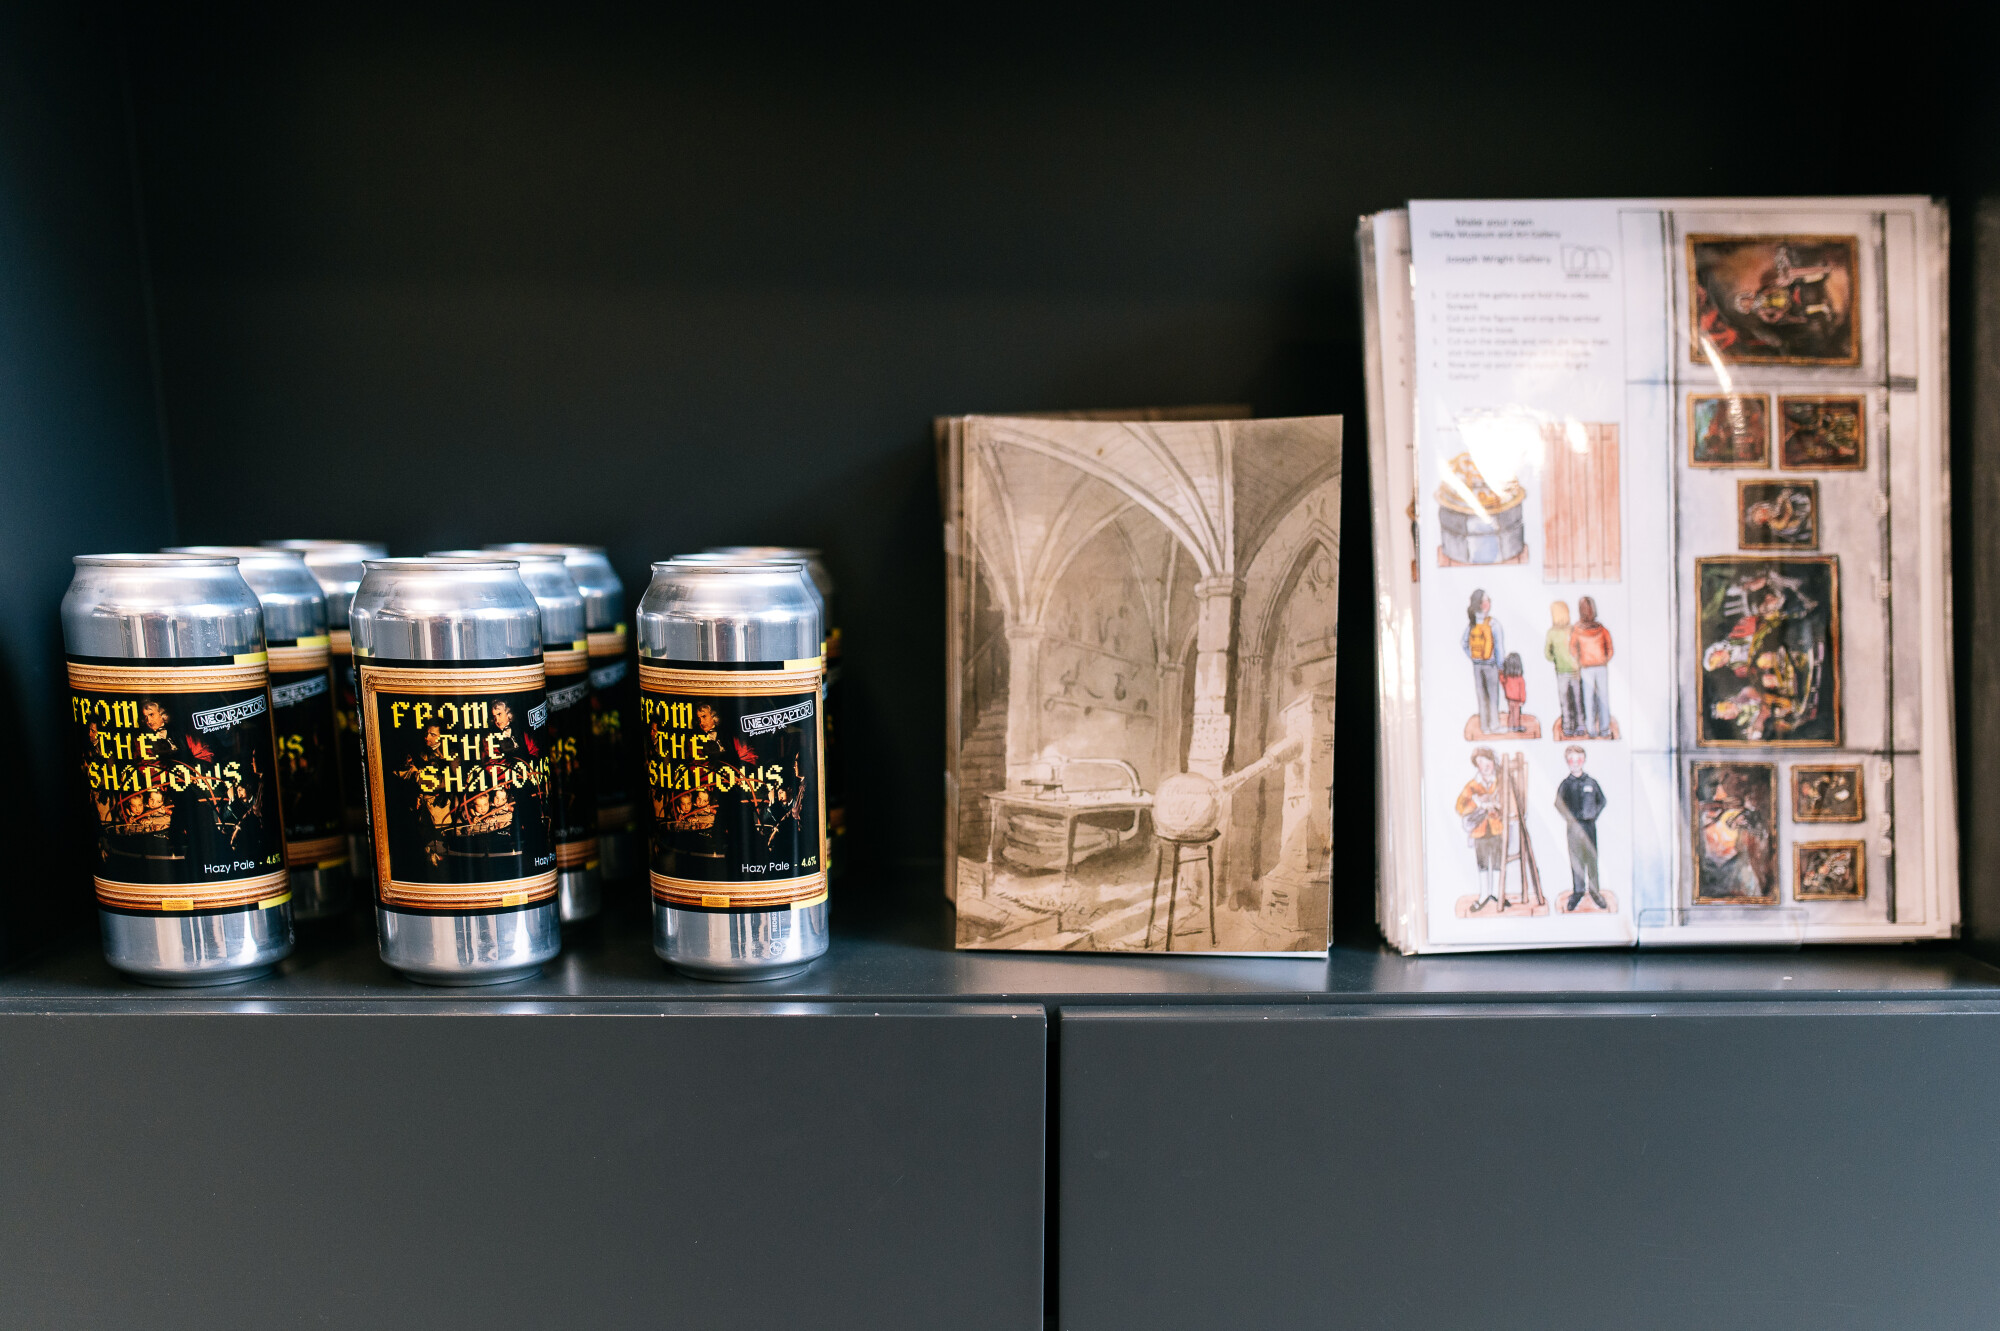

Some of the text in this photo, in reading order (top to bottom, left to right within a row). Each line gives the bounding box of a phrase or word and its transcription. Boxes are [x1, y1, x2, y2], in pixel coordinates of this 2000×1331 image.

[1457, 230, 1495, 240] Museum
[1497, 230, 1513, 240] and
[1531, 230, 1561, 240] Gallery
[1446, 254, 1552, 266] Joseph Wright Gallery
[71, 695, 140, 729] FROM
[200, 698, 264, 727] NEONRAPTOR
[390, 700, 490, 730] FROM
[747, 704, 812, 729] NEONRAPTOR
[95, 731, 161, 761] THE
[435, 732, 508, 762] THE
[656, 730, 711, 761] THE
[88, 760, 242, 793] SHADOWS
[419, 756, 551, 793] SHADOWS
[648, 763, 784, 793] SHADOWS
[204, 861, 231, 875] Hazy
[233, 858, 255, 872] Pale
[265, 854, 282, 866] 4.6%
[534, 856, 548, 867] Hazy
[741, 863, 767, 874] Hazy
[769, 860, 790, 872] Pale
[801, 855, 817, 868] 4.6%
